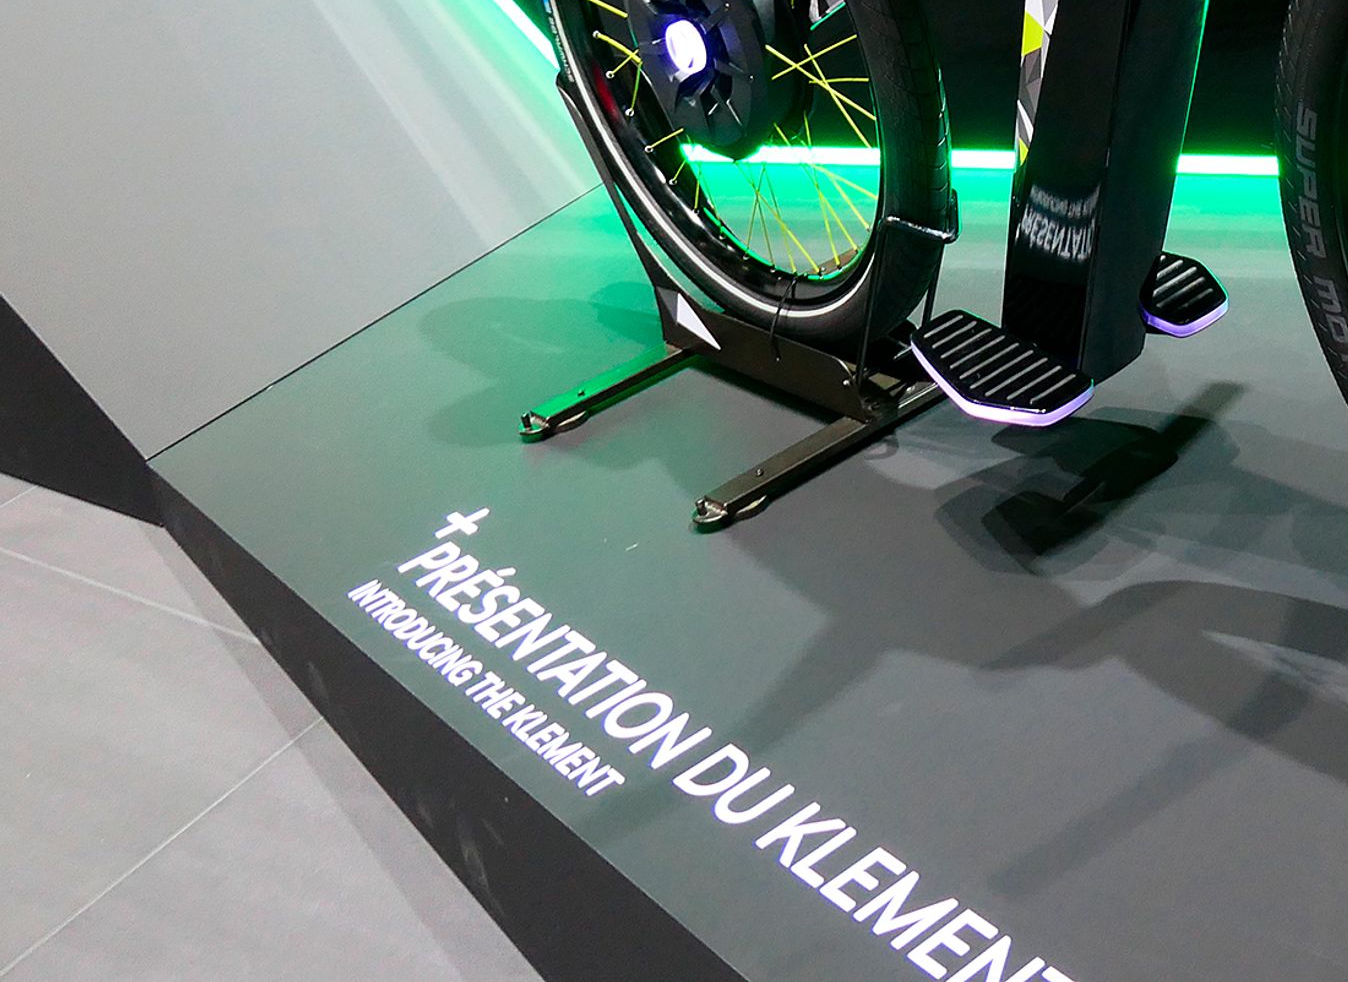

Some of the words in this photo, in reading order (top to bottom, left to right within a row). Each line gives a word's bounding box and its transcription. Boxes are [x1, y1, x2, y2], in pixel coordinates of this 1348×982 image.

[1295, 104, 1326, 259] SUPER
[346, 579, 484, 687] INTRODUCING
[465, 671, 526, 720] THE
[501, 705, 626, 797] KLEMENT
[397, 540, 711, 770] PRÉSENTATION
[673, 743, 795, 826] DU
[755, 802, 1075, 982] KLEMEN
